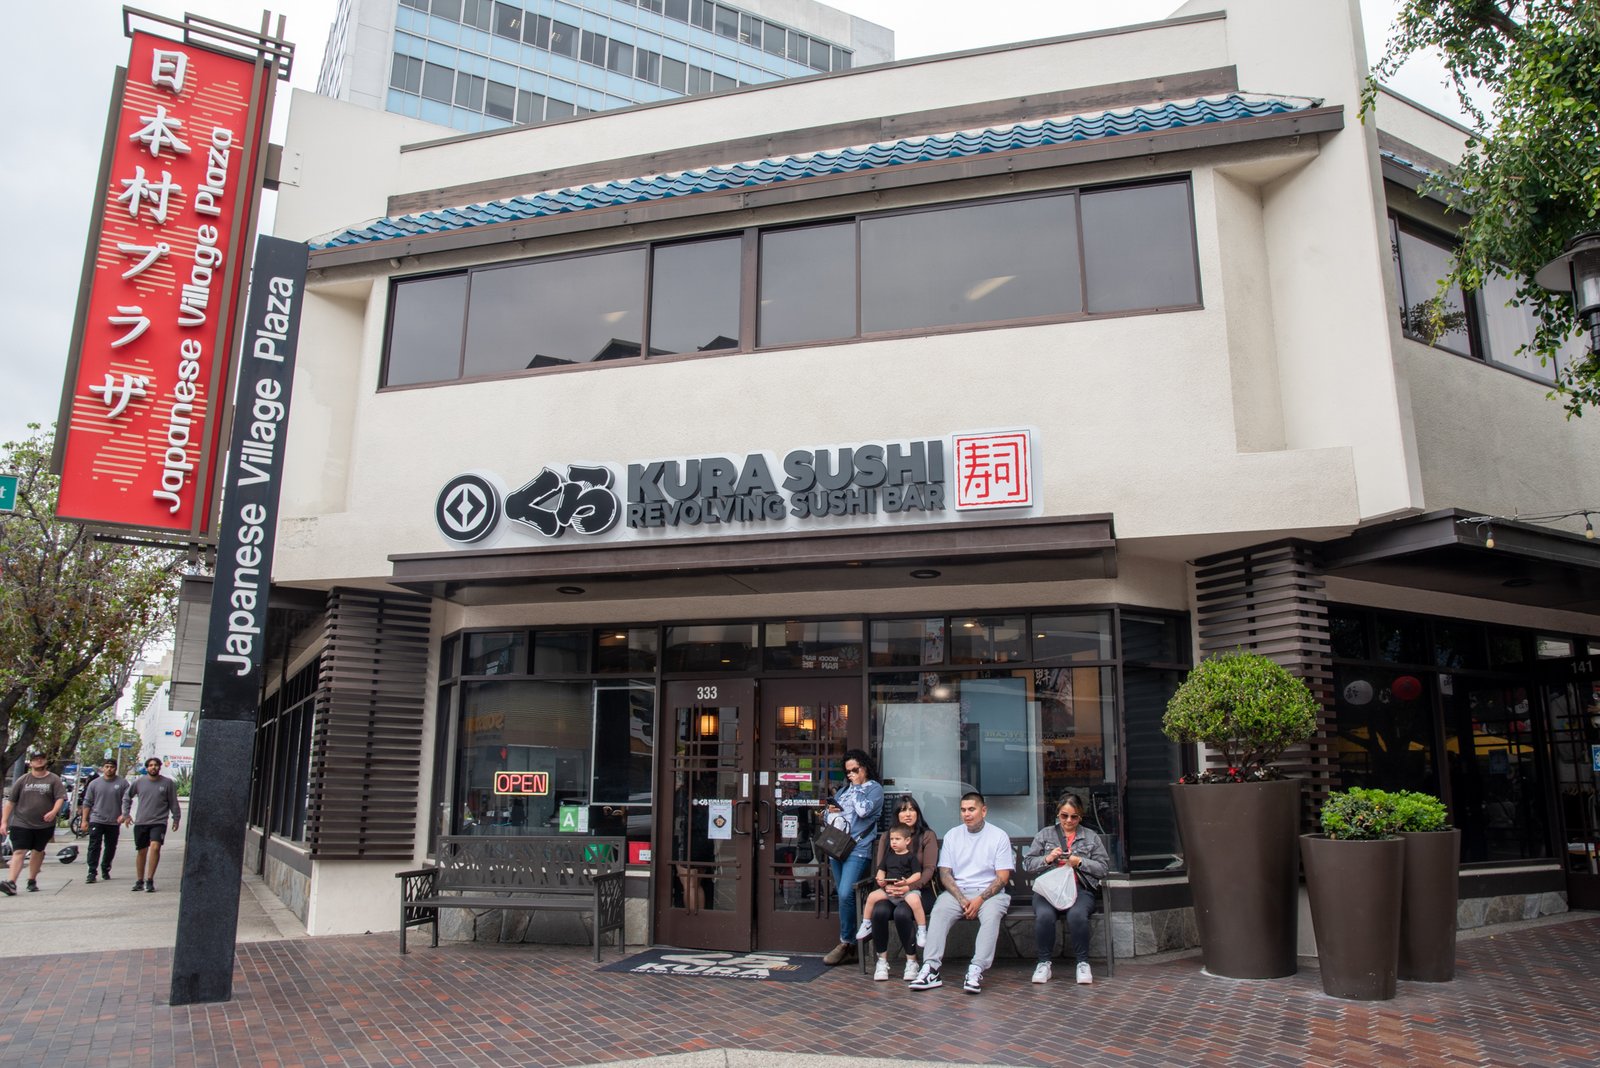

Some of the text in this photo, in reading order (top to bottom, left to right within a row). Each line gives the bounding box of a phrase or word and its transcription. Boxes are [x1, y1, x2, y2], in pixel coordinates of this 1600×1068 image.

[89, 48, 192, 418] 日本村プラザ
[153, 126, 232, 514] Japanese Village Plaza
[217, 276, 294, 676] Japanese Village Plaza
[627, 440, 945, 503] KURA SUSHI
[963, 443, 1021, 499] 寿司
[626, 483, 946, 529] REVOLVING SUSHI BAR
[1571, 660, 1593, 674] 141
[697, 686, 717, 700] 333
[497, 774, 546, 792] OPEN
[563, 812, 575, 827] A
[636, 962, 770, 976] KURA
